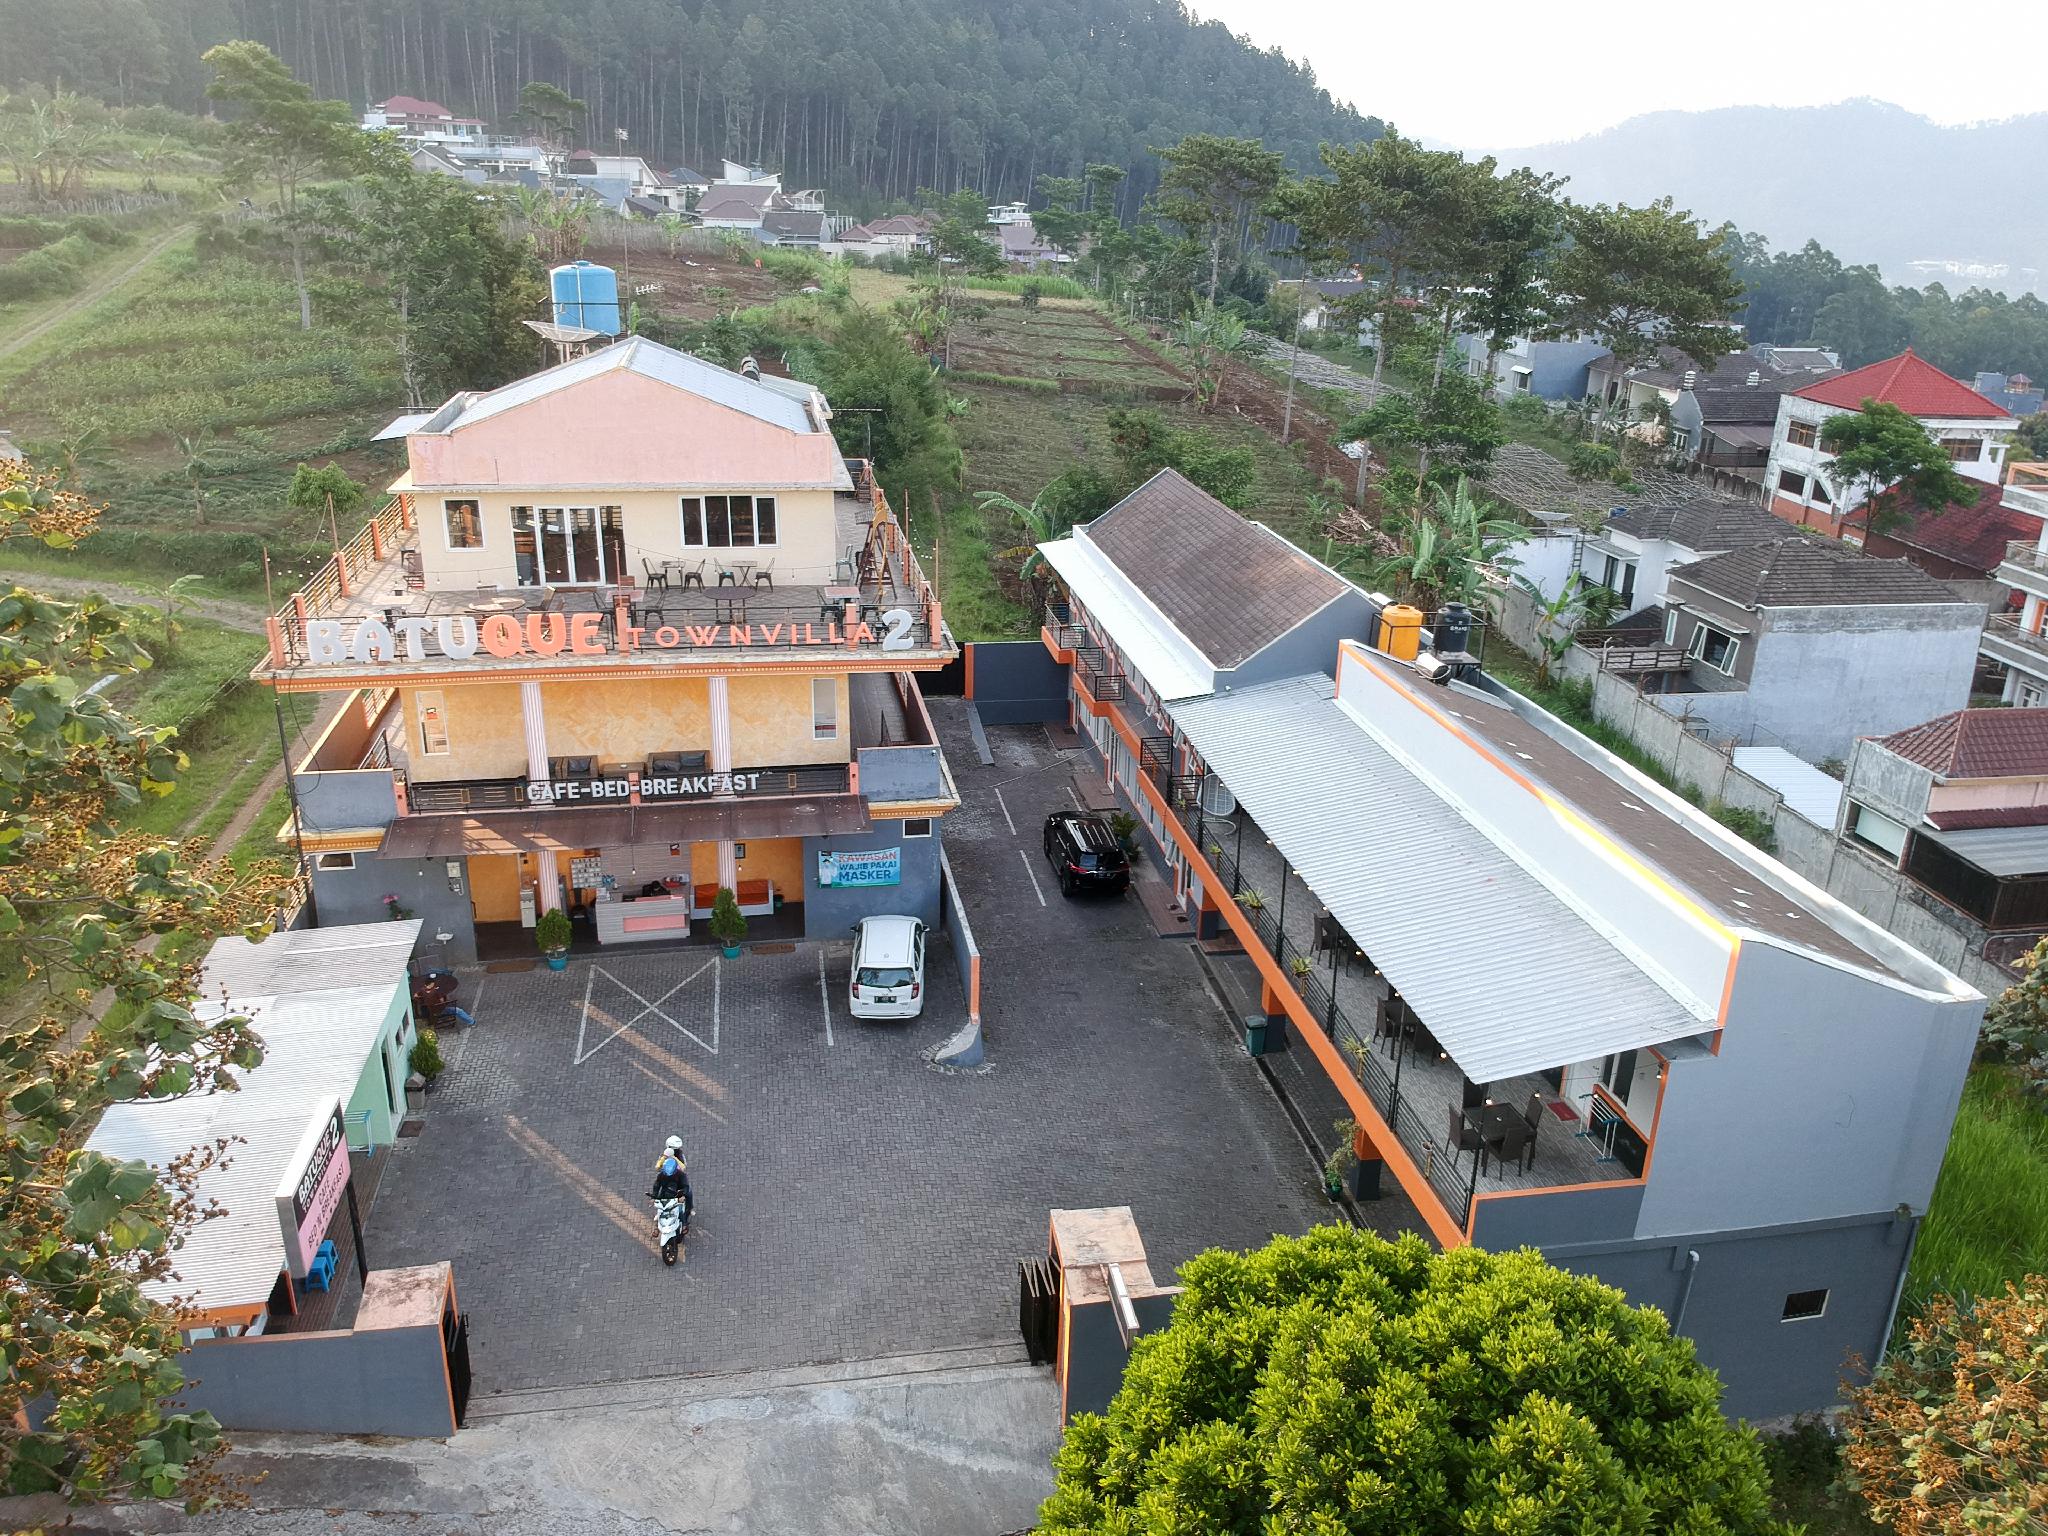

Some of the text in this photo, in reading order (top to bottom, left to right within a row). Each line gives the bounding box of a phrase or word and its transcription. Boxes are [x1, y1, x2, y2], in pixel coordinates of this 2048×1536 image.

[306, 608, 914, 663] BATUQUE TOWNVILLA 2
[839, 851, 896, 862] KAWASAN
[840, 861, 897, 871] WAJIB PAKAI
[839, 870, 891, 881] MASKER
[299, 1116, 340, 1204] BATUQUE 2
